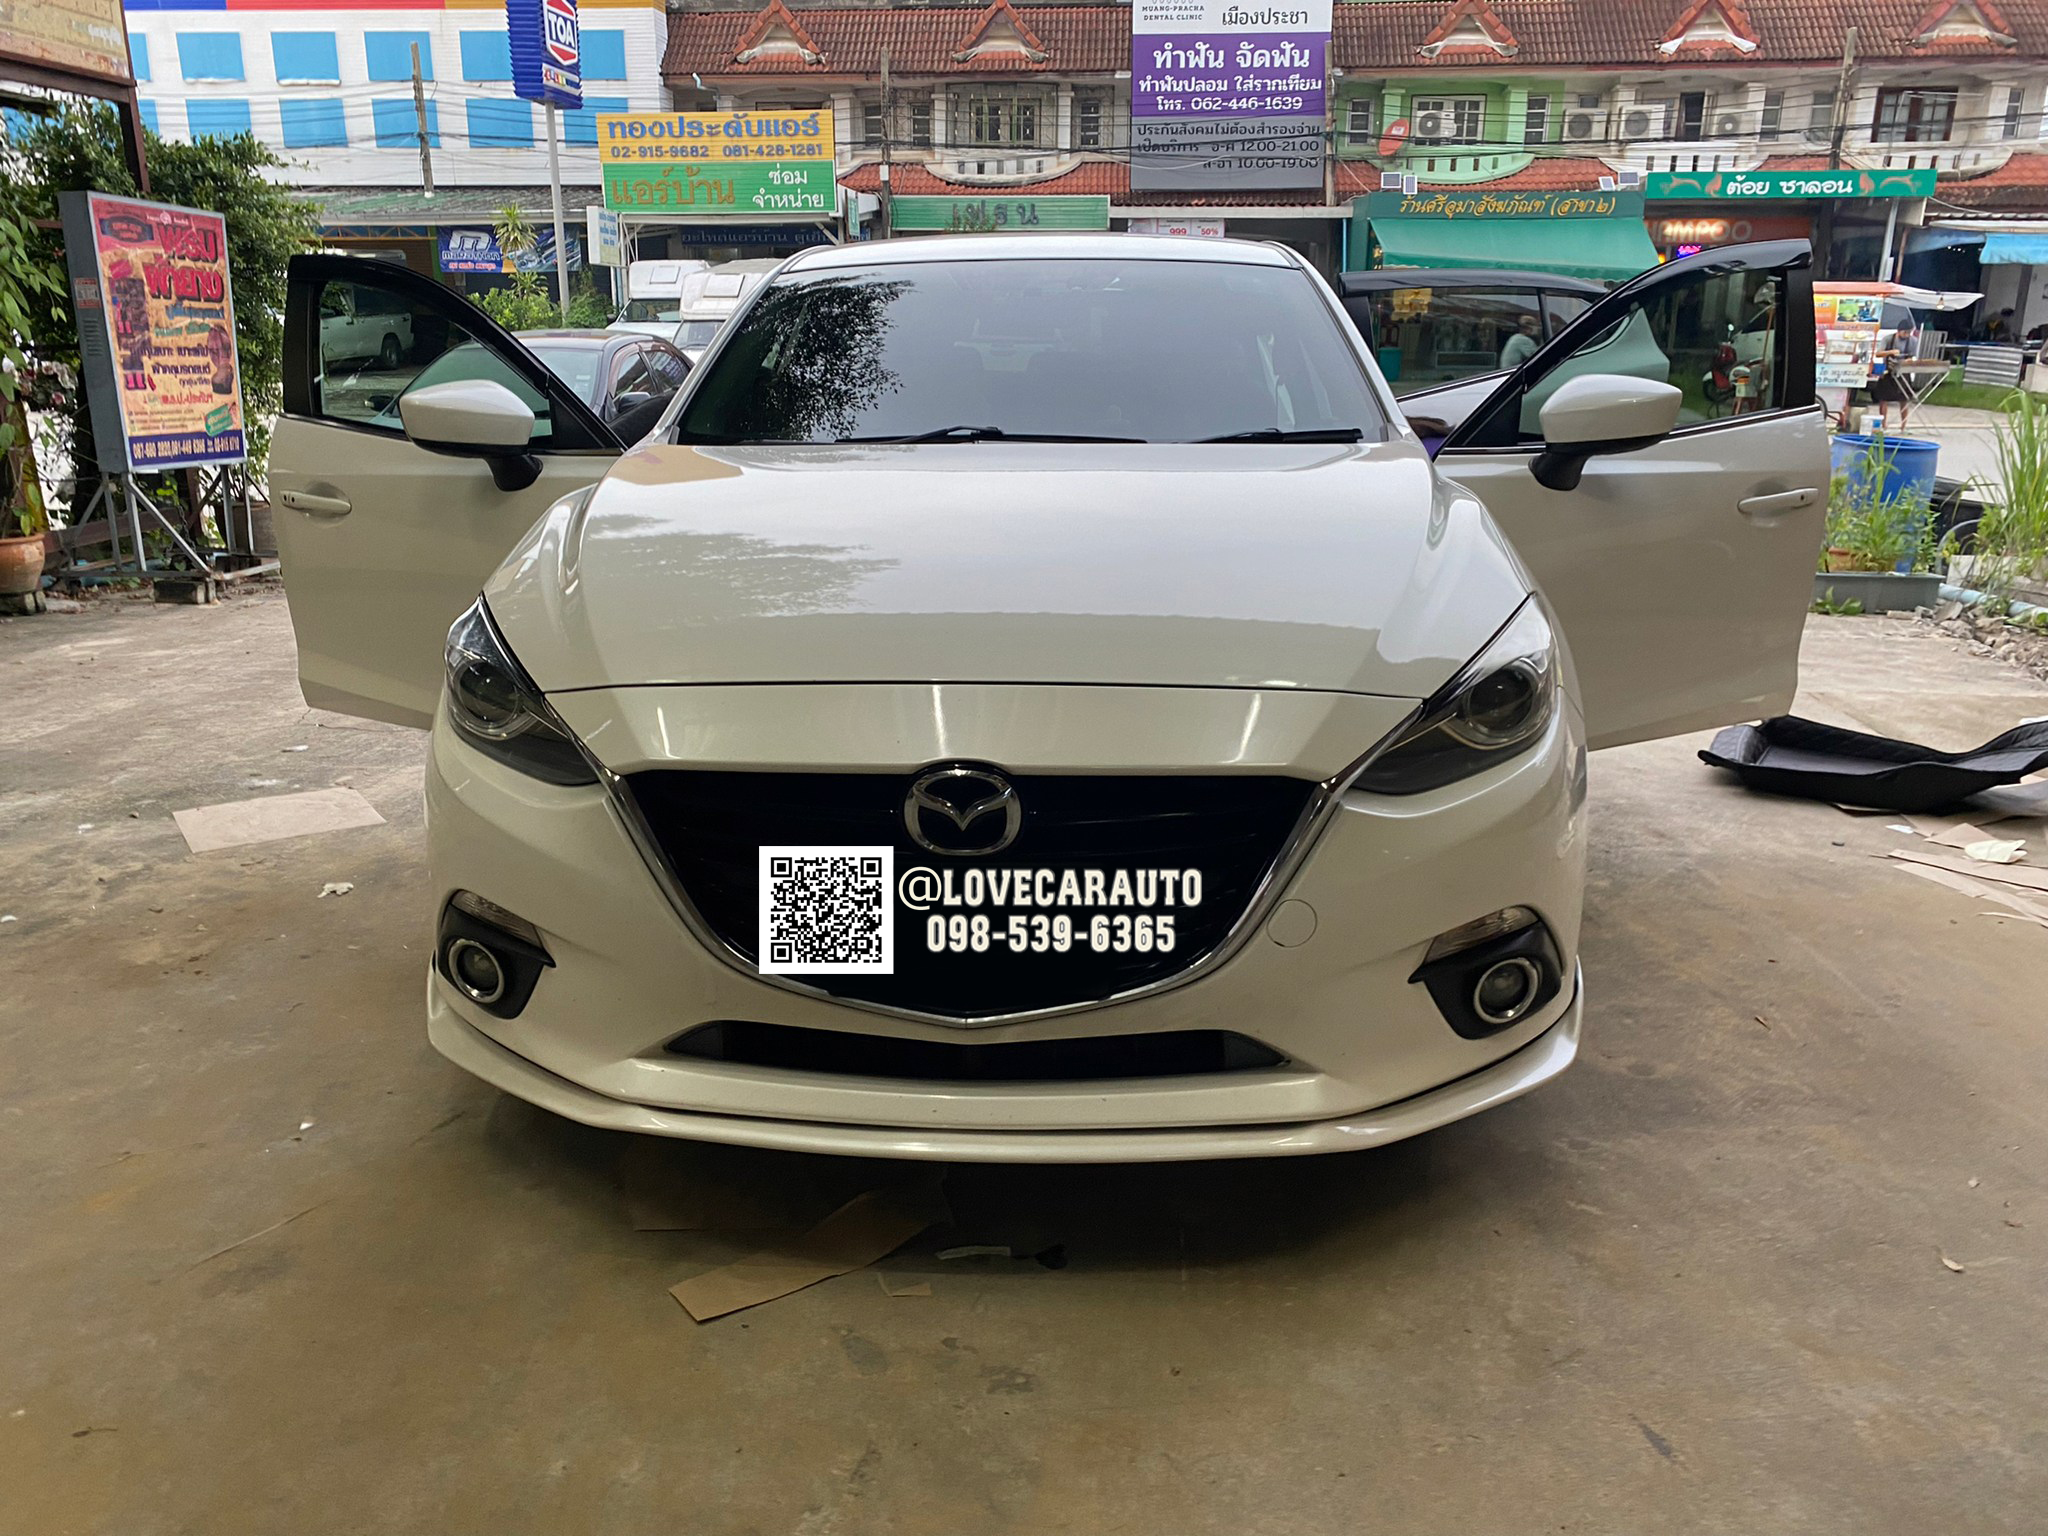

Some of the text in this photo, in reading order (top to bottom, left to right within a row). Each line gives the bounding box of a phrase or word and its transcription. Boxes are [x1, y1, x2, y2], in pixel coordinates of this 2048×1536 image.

[1222, 5, 1308, 26] เมืองประชา
[547, 11, 575, 48] TOA
[1153, 41, 1310, 69] ทำฟัน จัดฟัน
[1138, 74, 1322, 93] ทำฟันปลอม ใส่รากเทียม
[1156, 96, 1303, 111] โทร. 062-446-1639
[607, 112, 821, 139] ทองประดับแอร์
[1137, 121, 1320, 136] ประกันสังคมไม่ต้องสำรองจ่าย
[610, 143, 823, 158] 02-915-9682 081-428-1281
[767, 163, 808, 186] ซ่อม
[1726, 174, 1853, 195] ต้อย ซาลอน
[611, 166, 736, 206] แอร์บ้าน
[752, 188, 825, 209] จำหน่าย
[1200, 228, 1219, 236] 50%
